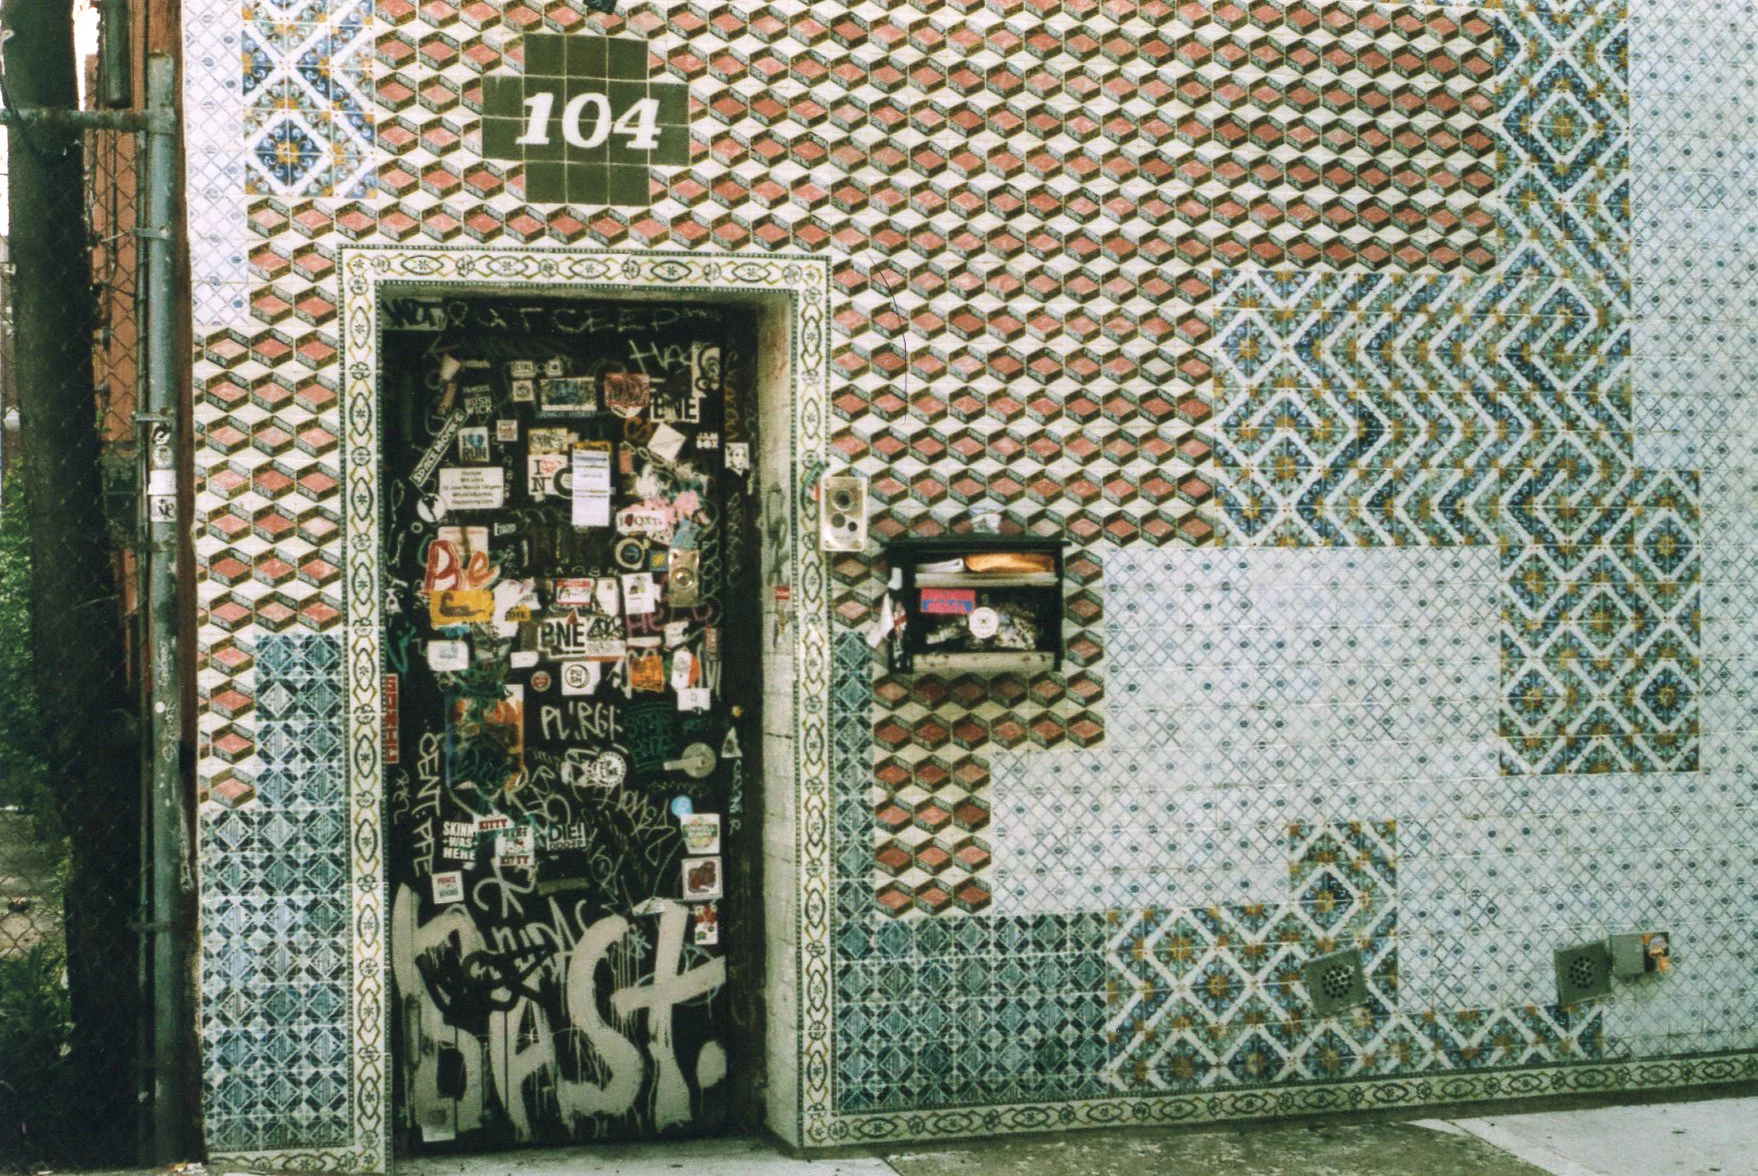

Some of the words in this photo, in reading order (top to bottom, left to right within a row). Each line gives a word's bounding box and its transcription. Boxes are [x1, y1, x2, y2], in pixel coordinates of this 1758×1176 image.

[515, 92, 662, 149] 104
[540, 619, 586, 649] BNE
[478, 818, 508, 831] KITTY
[442, 847, 477, 860] HERE
